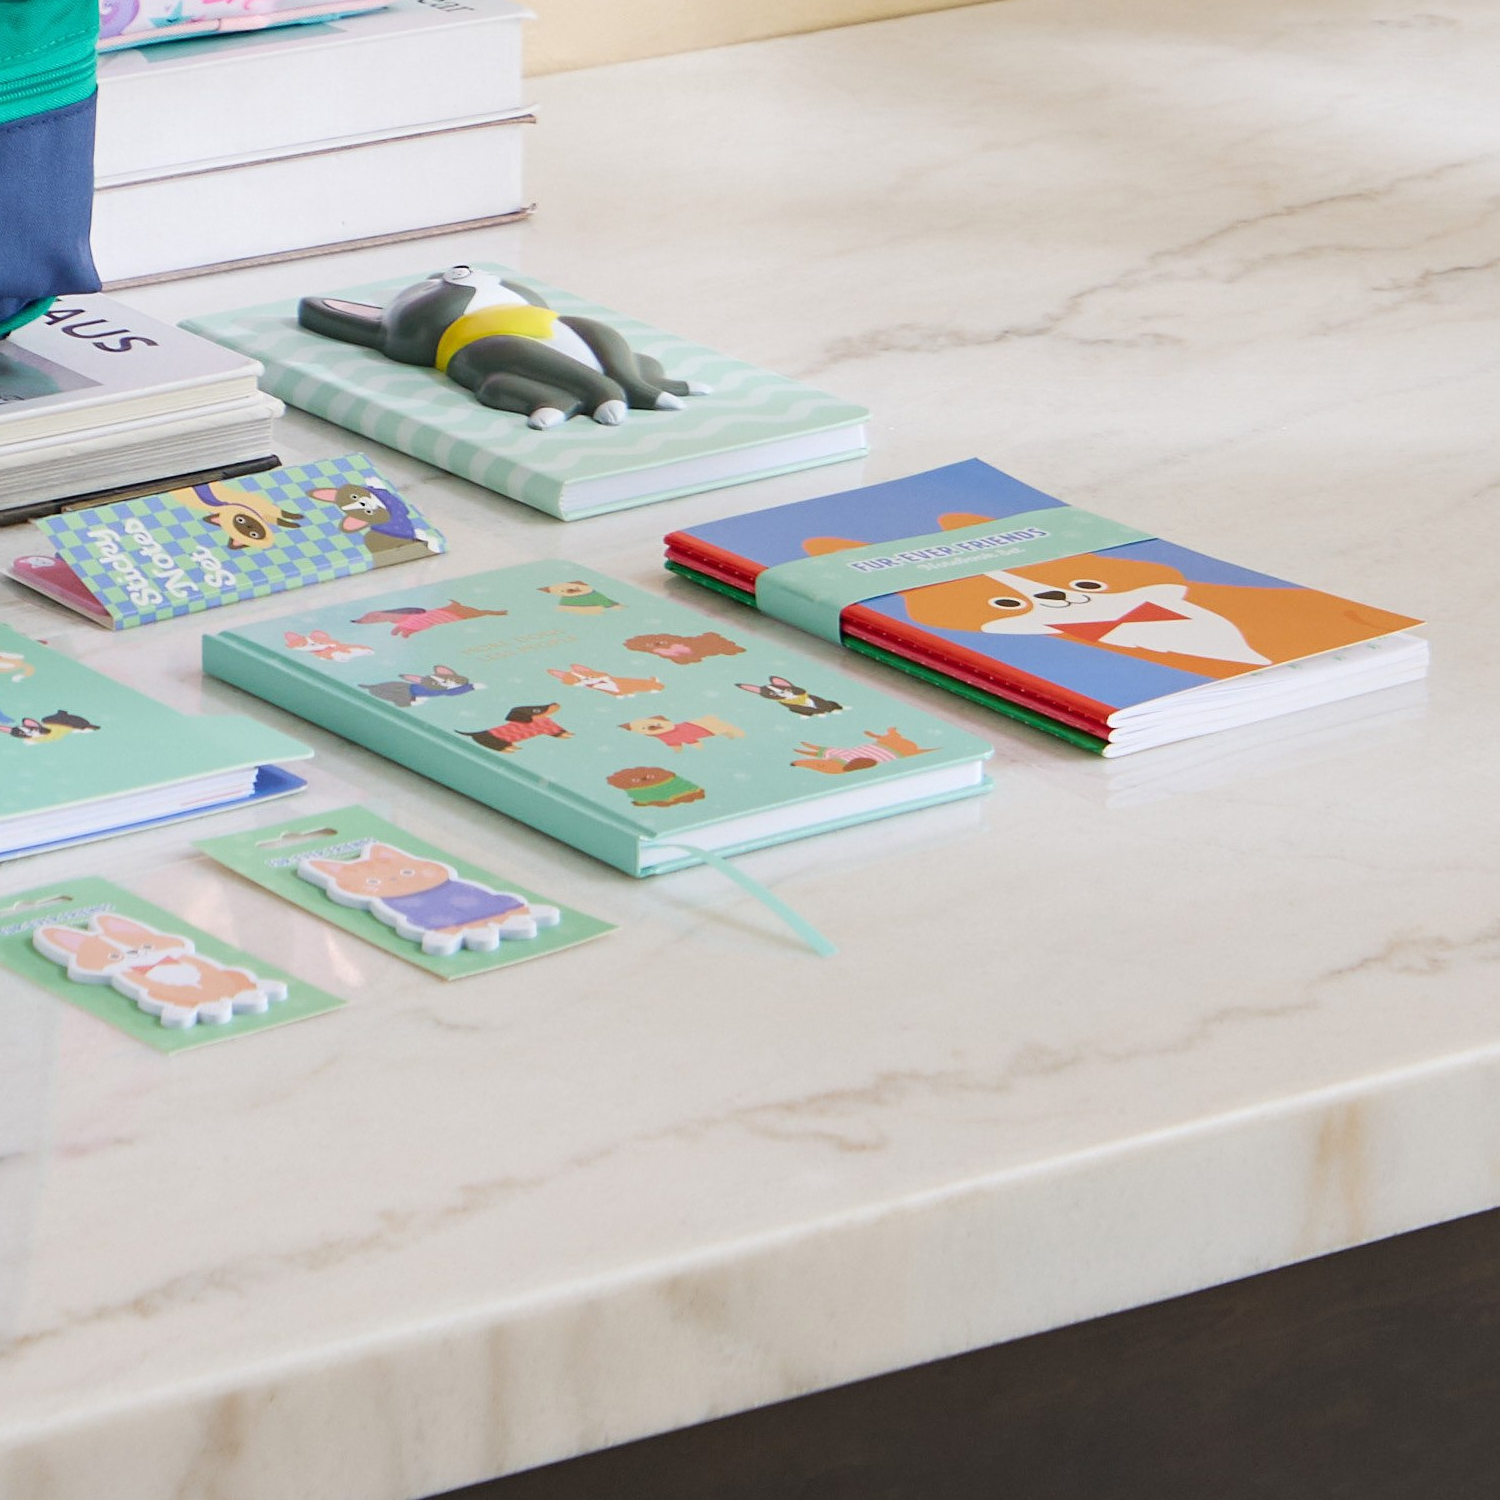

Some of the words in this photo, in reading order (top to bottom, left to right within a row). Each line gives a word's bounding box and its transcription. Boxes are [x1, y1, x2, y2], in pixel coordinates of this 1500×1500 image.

[44, 298, 159, 353] AUS
[87, 528, 163, 606] Sticky
[124, 517, 199, 598] Notes
[190, 545, 237, 588] Set
[850, 544, 960, 573] FUR-EVER
[956, 526, 1049, 553] FRIENDS
